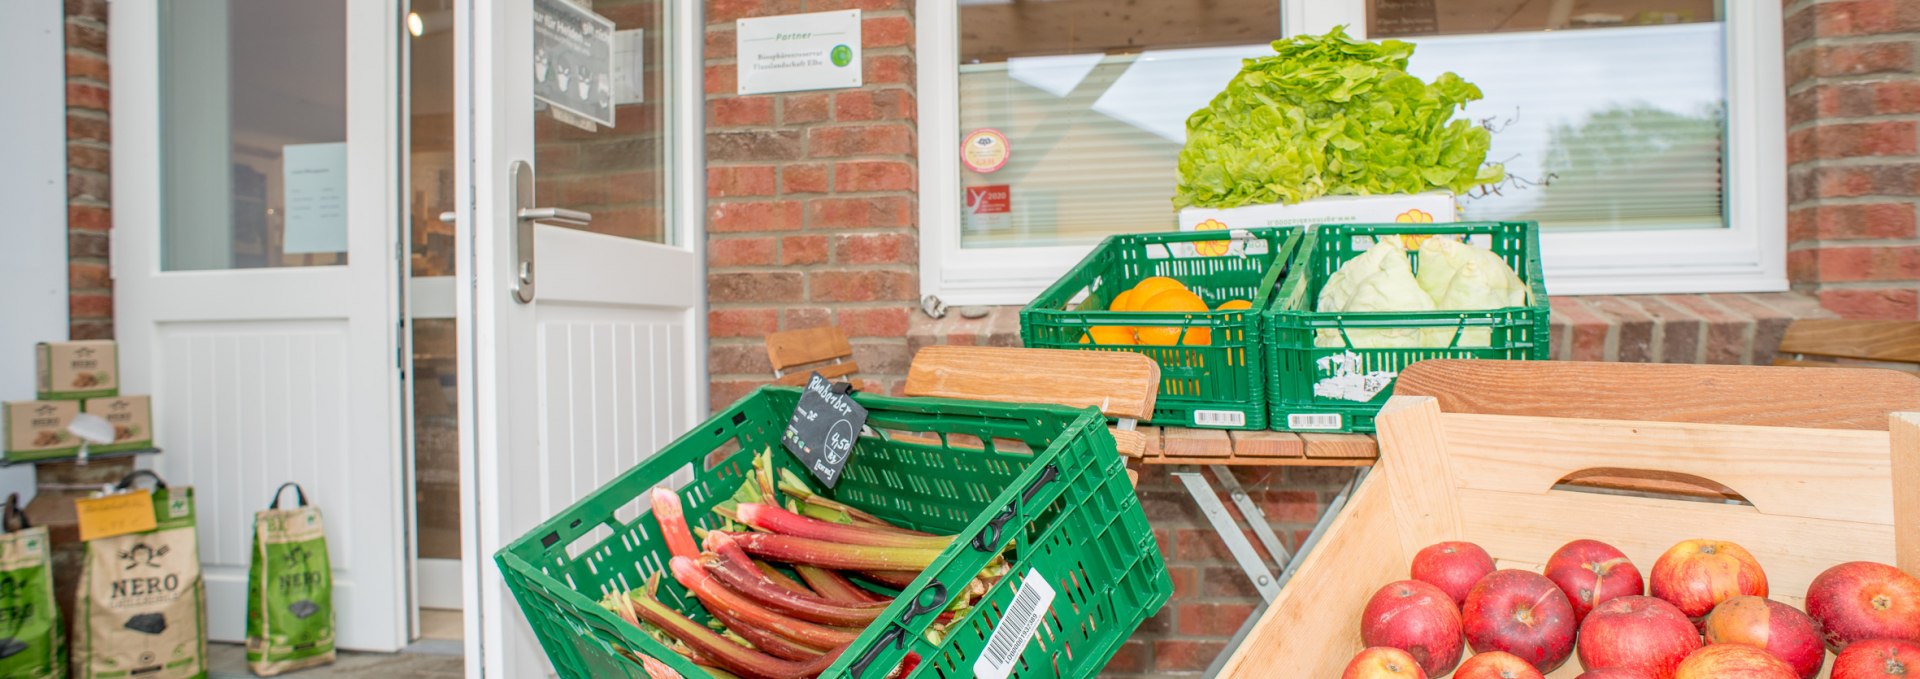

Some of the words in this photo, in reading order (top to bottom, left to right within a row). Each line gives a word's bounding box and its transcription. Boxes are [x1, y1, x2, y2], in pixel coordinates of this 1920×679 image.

[776, 31, 812, 41] Partner
[808, 375, 852, 416] Rhabarber
[831, 432, 851, 451] 4,50
[111, 573, 178, 598] NERO
[279, 571, 321, 590] NERO
